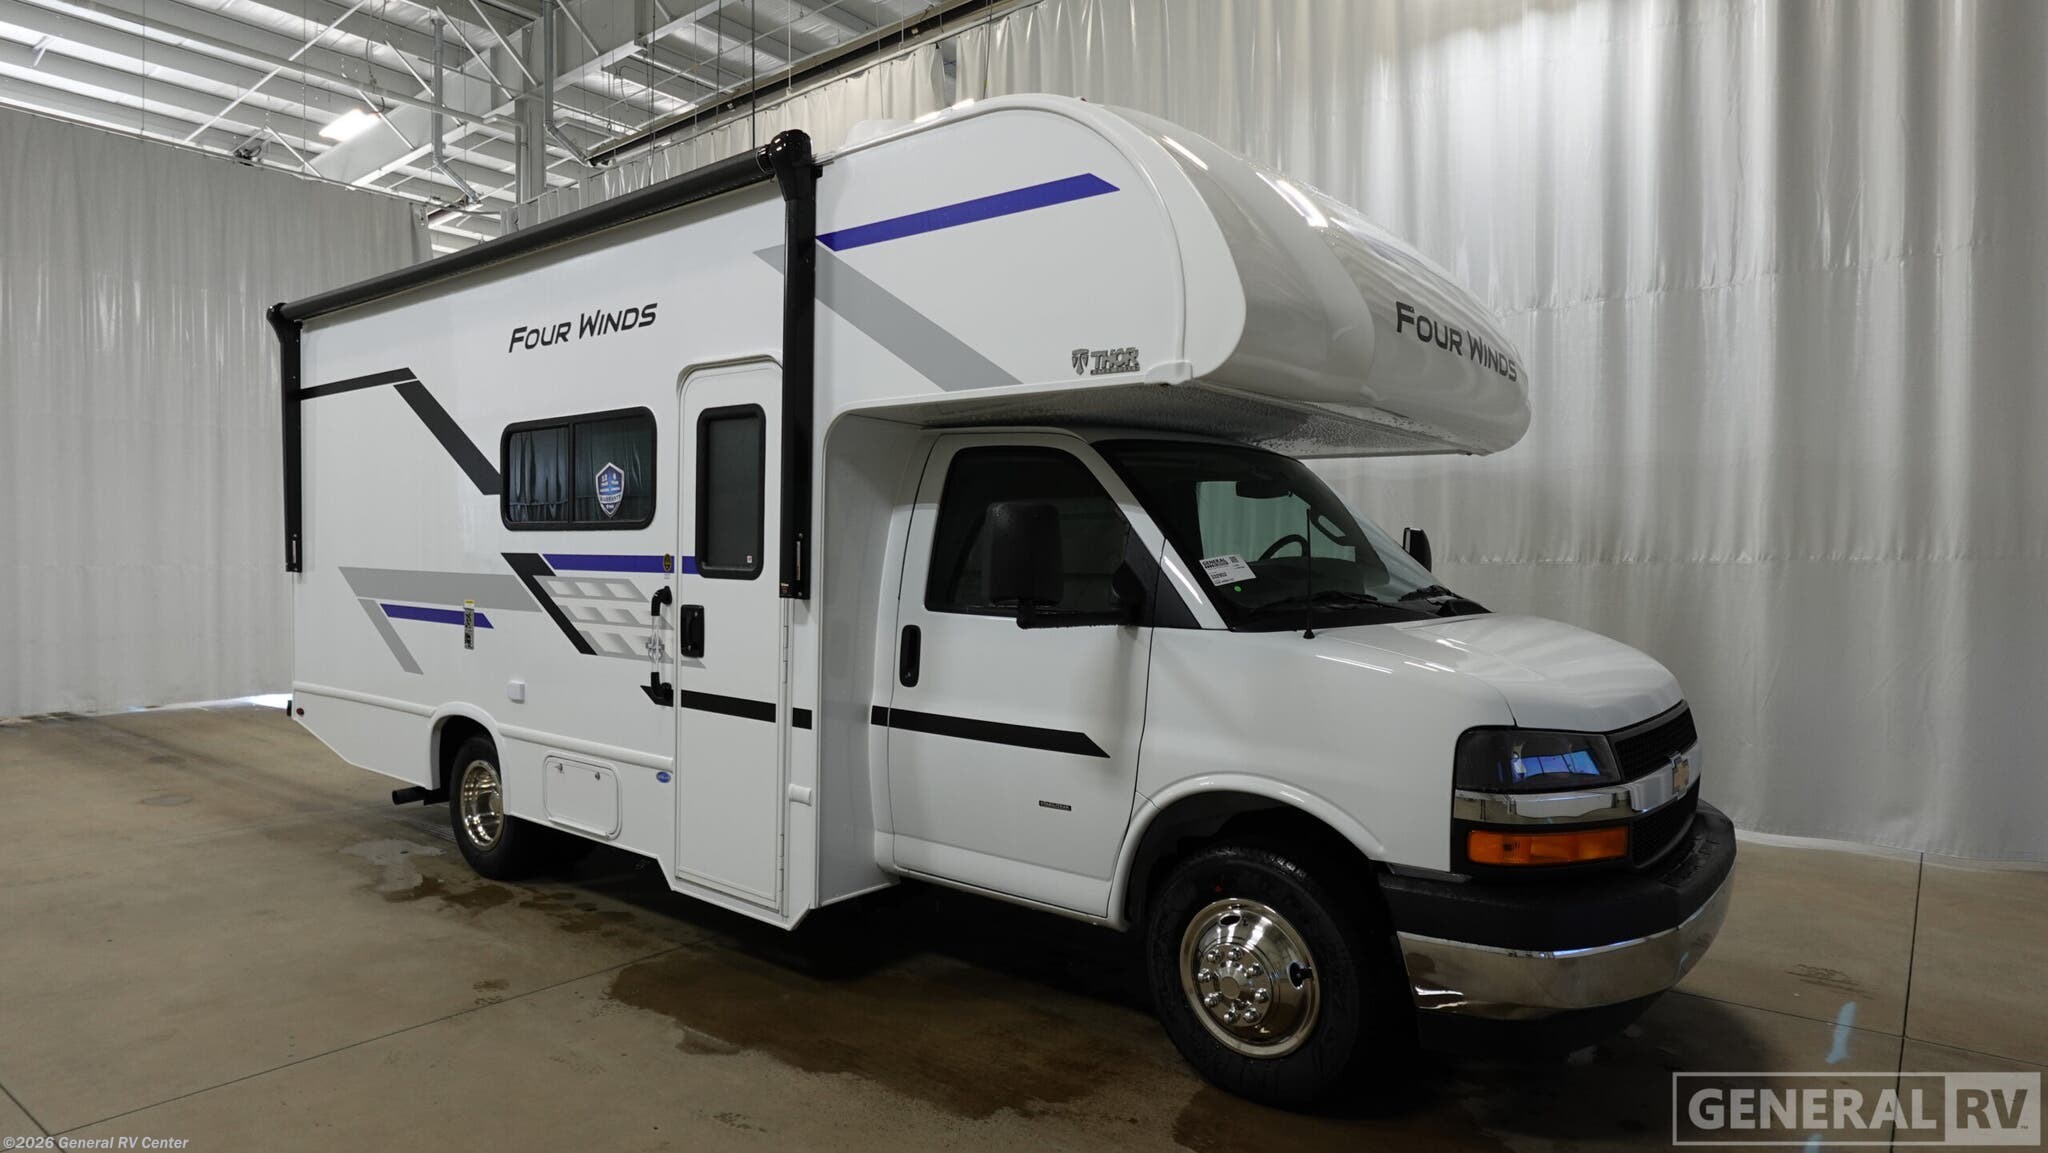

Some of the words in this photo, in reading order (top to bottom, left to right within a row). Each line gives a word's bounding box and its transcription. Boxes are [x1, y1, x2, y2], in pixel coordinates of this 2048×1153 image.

[508, 321, 572, 354] FOUR
[578, 302, 658, 340] WINDS
[1395, 300, 1463, 357] FOUR
[1466, 329, 1518, 383] WINDS
[1090, 346, 1140, 371] THOR
